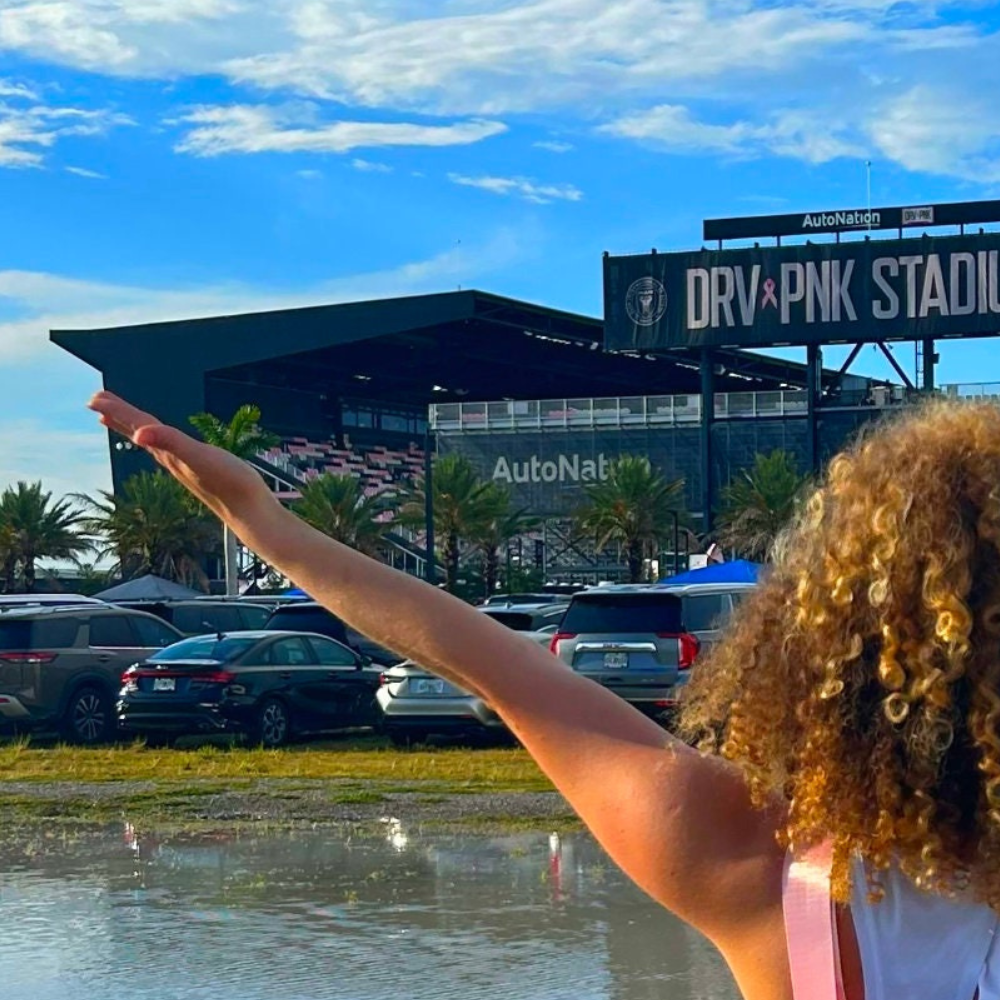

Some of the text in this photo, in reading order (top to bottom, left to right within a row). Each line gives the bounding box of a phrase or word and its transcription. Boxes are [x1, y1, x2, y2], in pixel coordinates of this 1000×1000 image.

[802, 211, 880, 228] AutoNation
[687, 265, 760, 330] DRV
[781, 259, 857, 325] PNK
